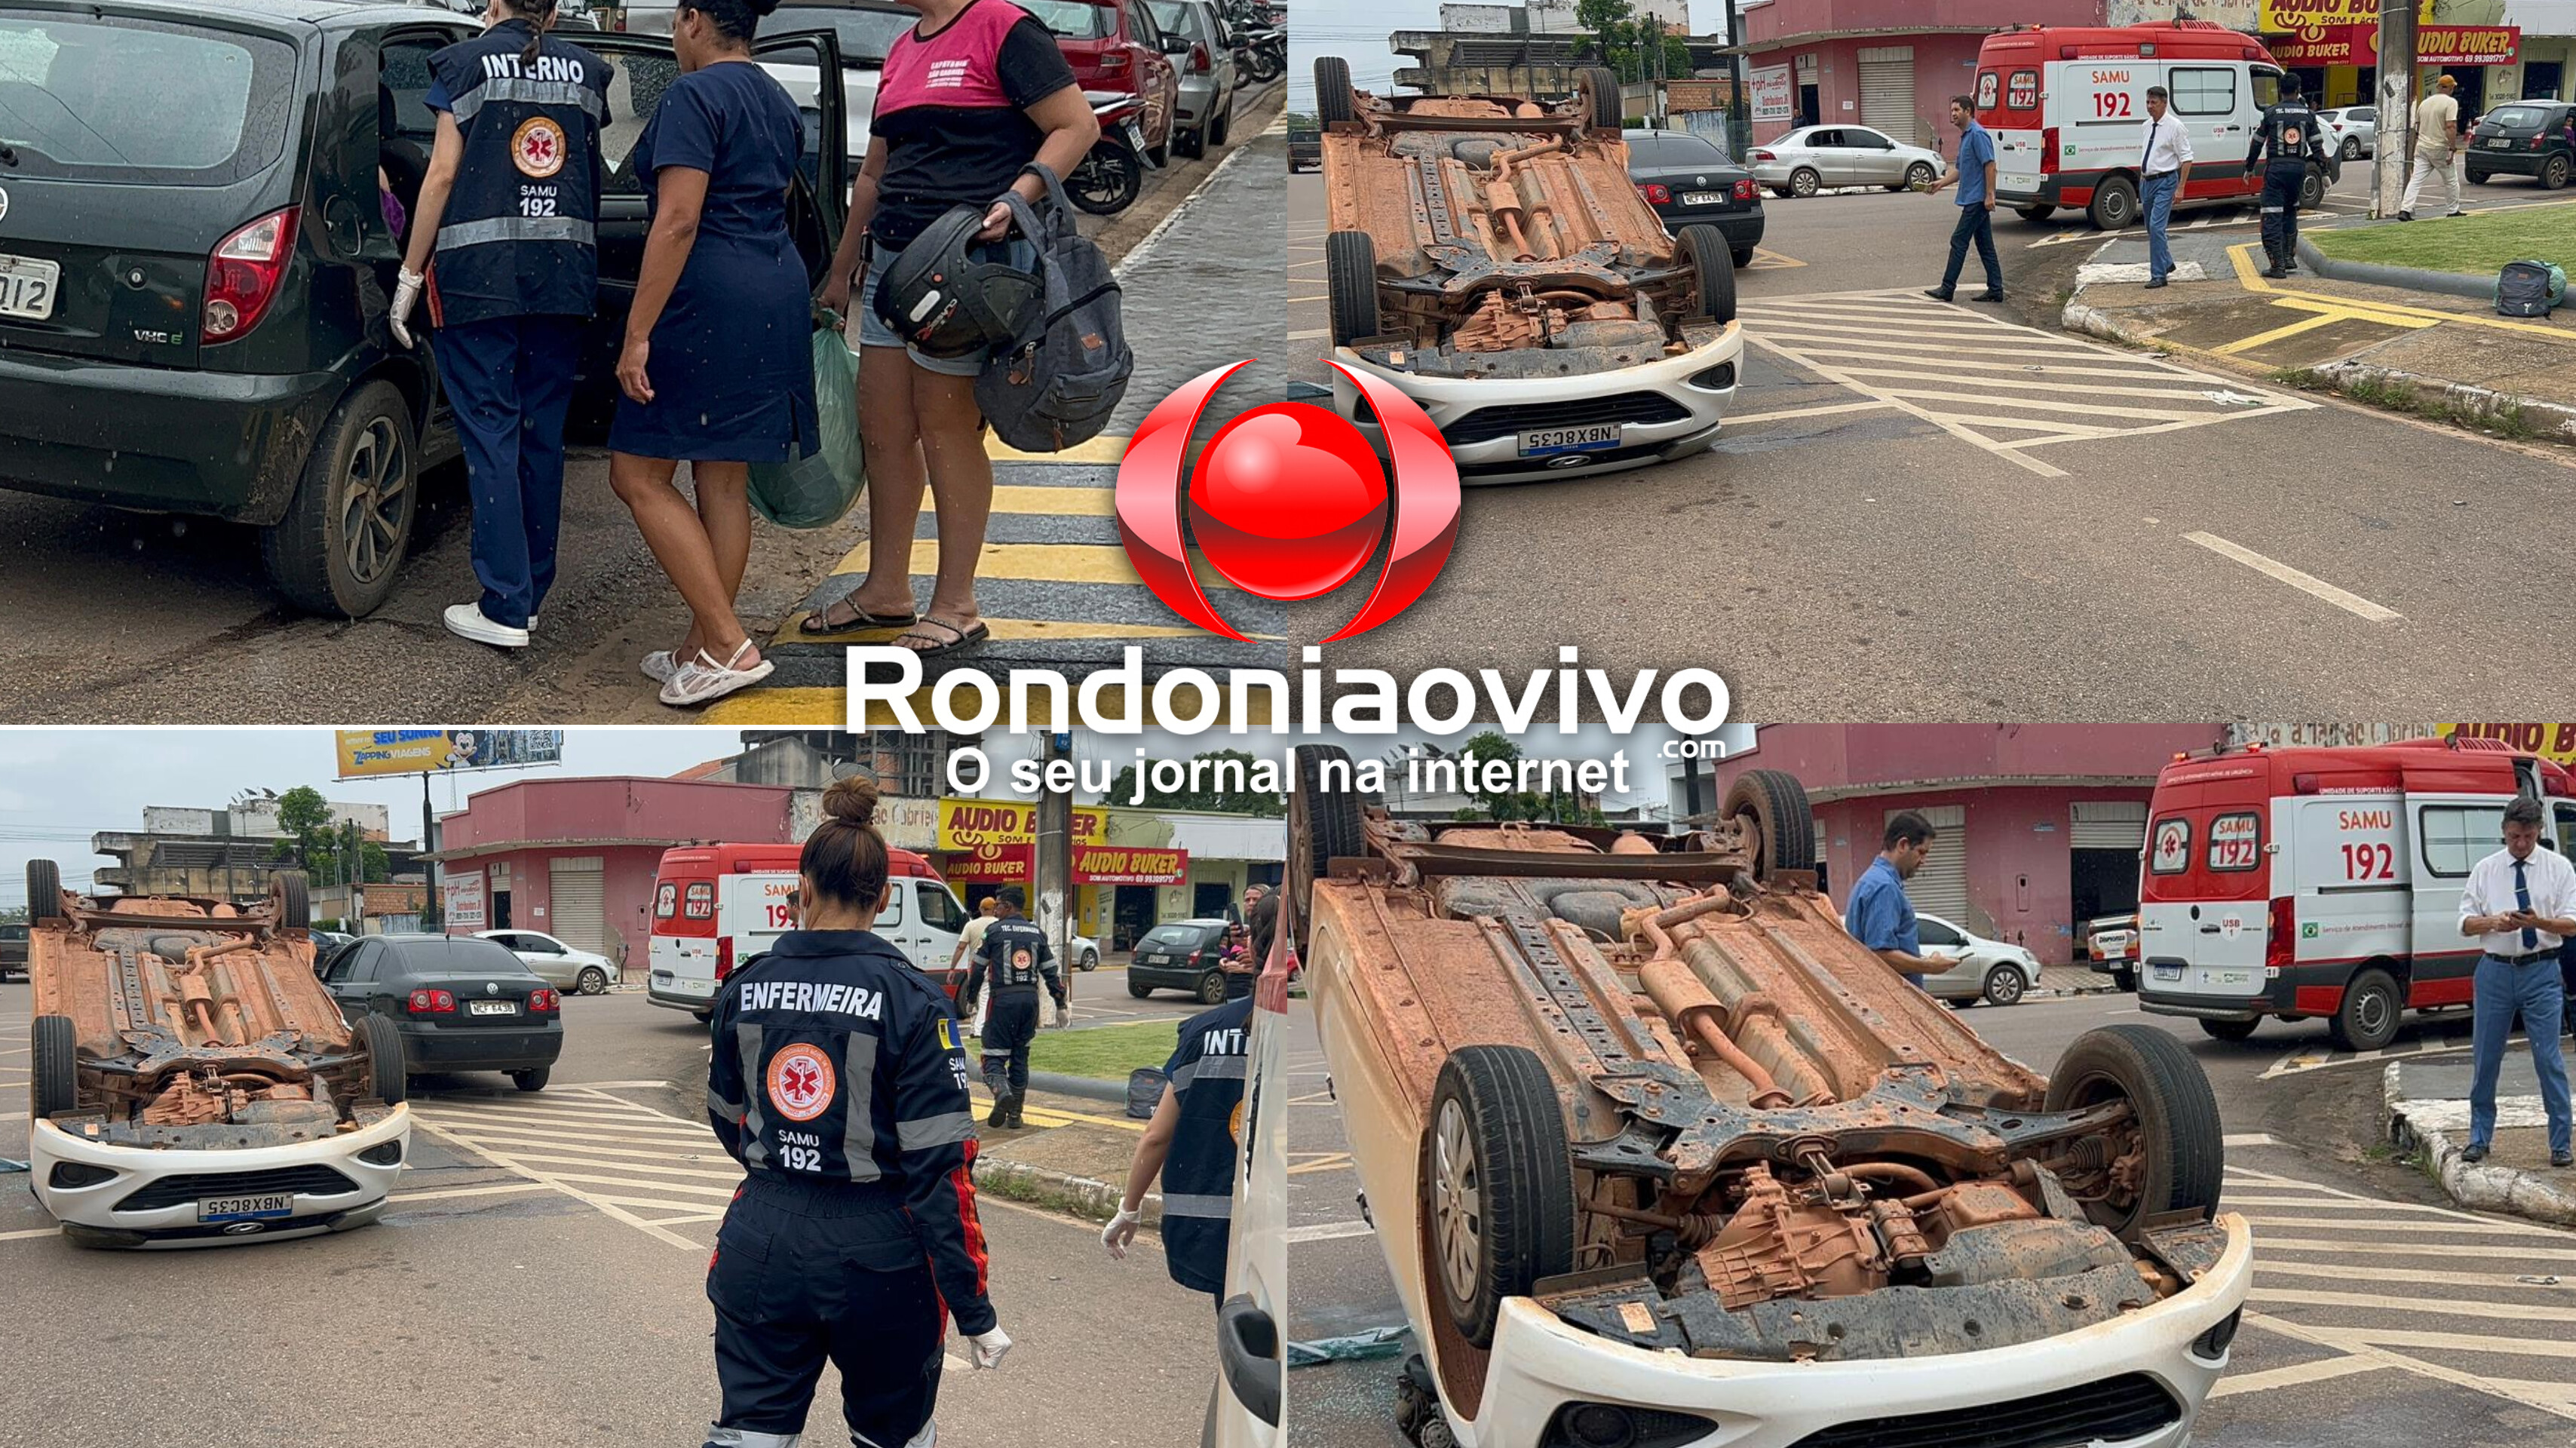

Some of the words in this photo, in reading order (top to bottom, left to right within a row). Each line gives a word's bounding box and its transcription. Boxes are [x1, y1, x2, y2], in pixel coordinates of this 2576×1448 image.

[2321, 16, 2346, 24] SOM
[2270, 45, 2303, 58] AUDIO
[2307, 43, 2350, 57] BUKER
[2417, 32, 2456, 54] UDIO
[2459, 32, 2510, 54] BUKER
[2013, 75, 2035, 84] SAMU
[2092, 70, 2130, 84] SAMU
[2013, 89, 2034, 105] 192
[2093, 92, 2131, 117] 192
[520, 185, 557, 198] SAMU
[519, 198, 557, 217] 192
[133, 330, 167, 343] VHC
[1529, 426, 1612, 448] NBX8C35
[373, 731, 396, 745] SEU
[948, 806, 1017, 833] AUDIO
[1023, 811, 1097, 836] BER
[2219, 819, 2255, 834] SAMU
[2339, 810, 2391, 830] SAMU
[998, 835, 1023, 843] SOM
[2218, 839, 2254, 865] 192
[947, 862, 981, 875] AUDIO
[984, 861, 1025, 874] BUKER
[1078, 851, 1127, 873] AUDIO
[1130, 853, 1178, 873] BUKER
[2341, 843, 2394, 880] 192
[691, 887, 710, 896] SAMU
[765, 884, 795, 897] SAM
[690, 901, 710, 916] 192
[766, 904, 798, 928] 19
[2222, 919, 2240, 928] USB
[741, 981, 883, 1021] ENFERMEIRA
[778, 1129, 820, 1147] SAMU
[779, 1145, 822, 1172] 192
[208, 1196, 284, 1214] NBX8C35
